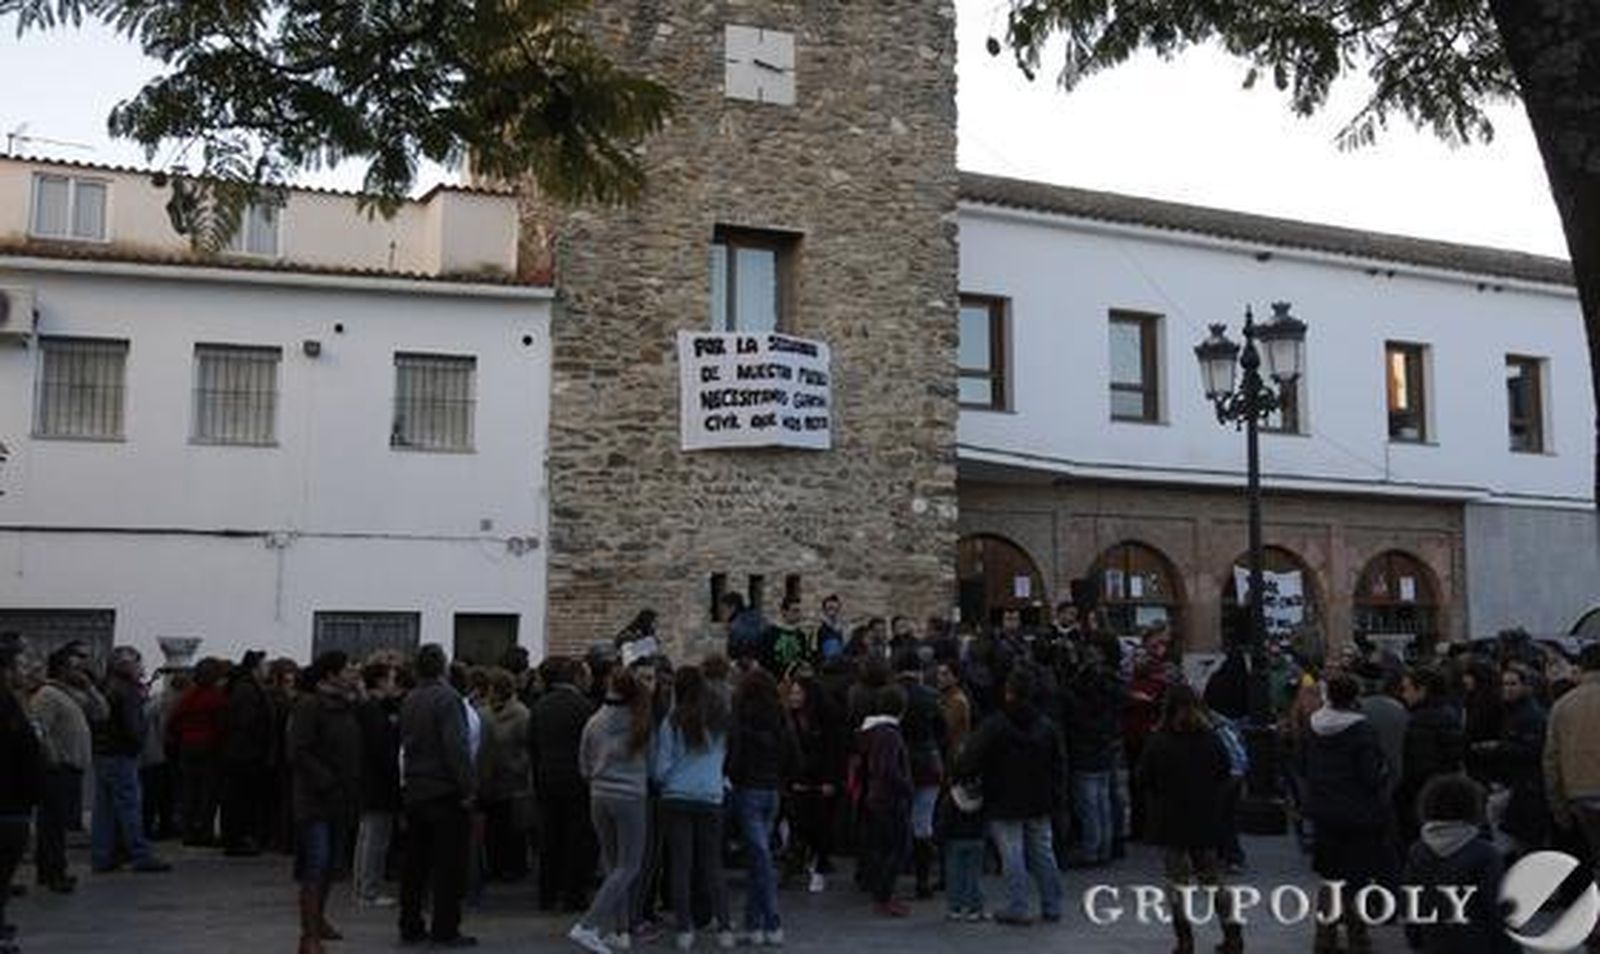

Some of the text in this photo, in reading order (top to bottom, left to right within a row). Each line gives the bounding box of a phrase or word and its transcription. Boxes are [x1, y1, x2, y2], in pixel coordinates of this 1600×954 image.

[694, 338, 725, 357] POR
[737, 337, 758, 354] LA
[701, 366, 721, 382] DE
